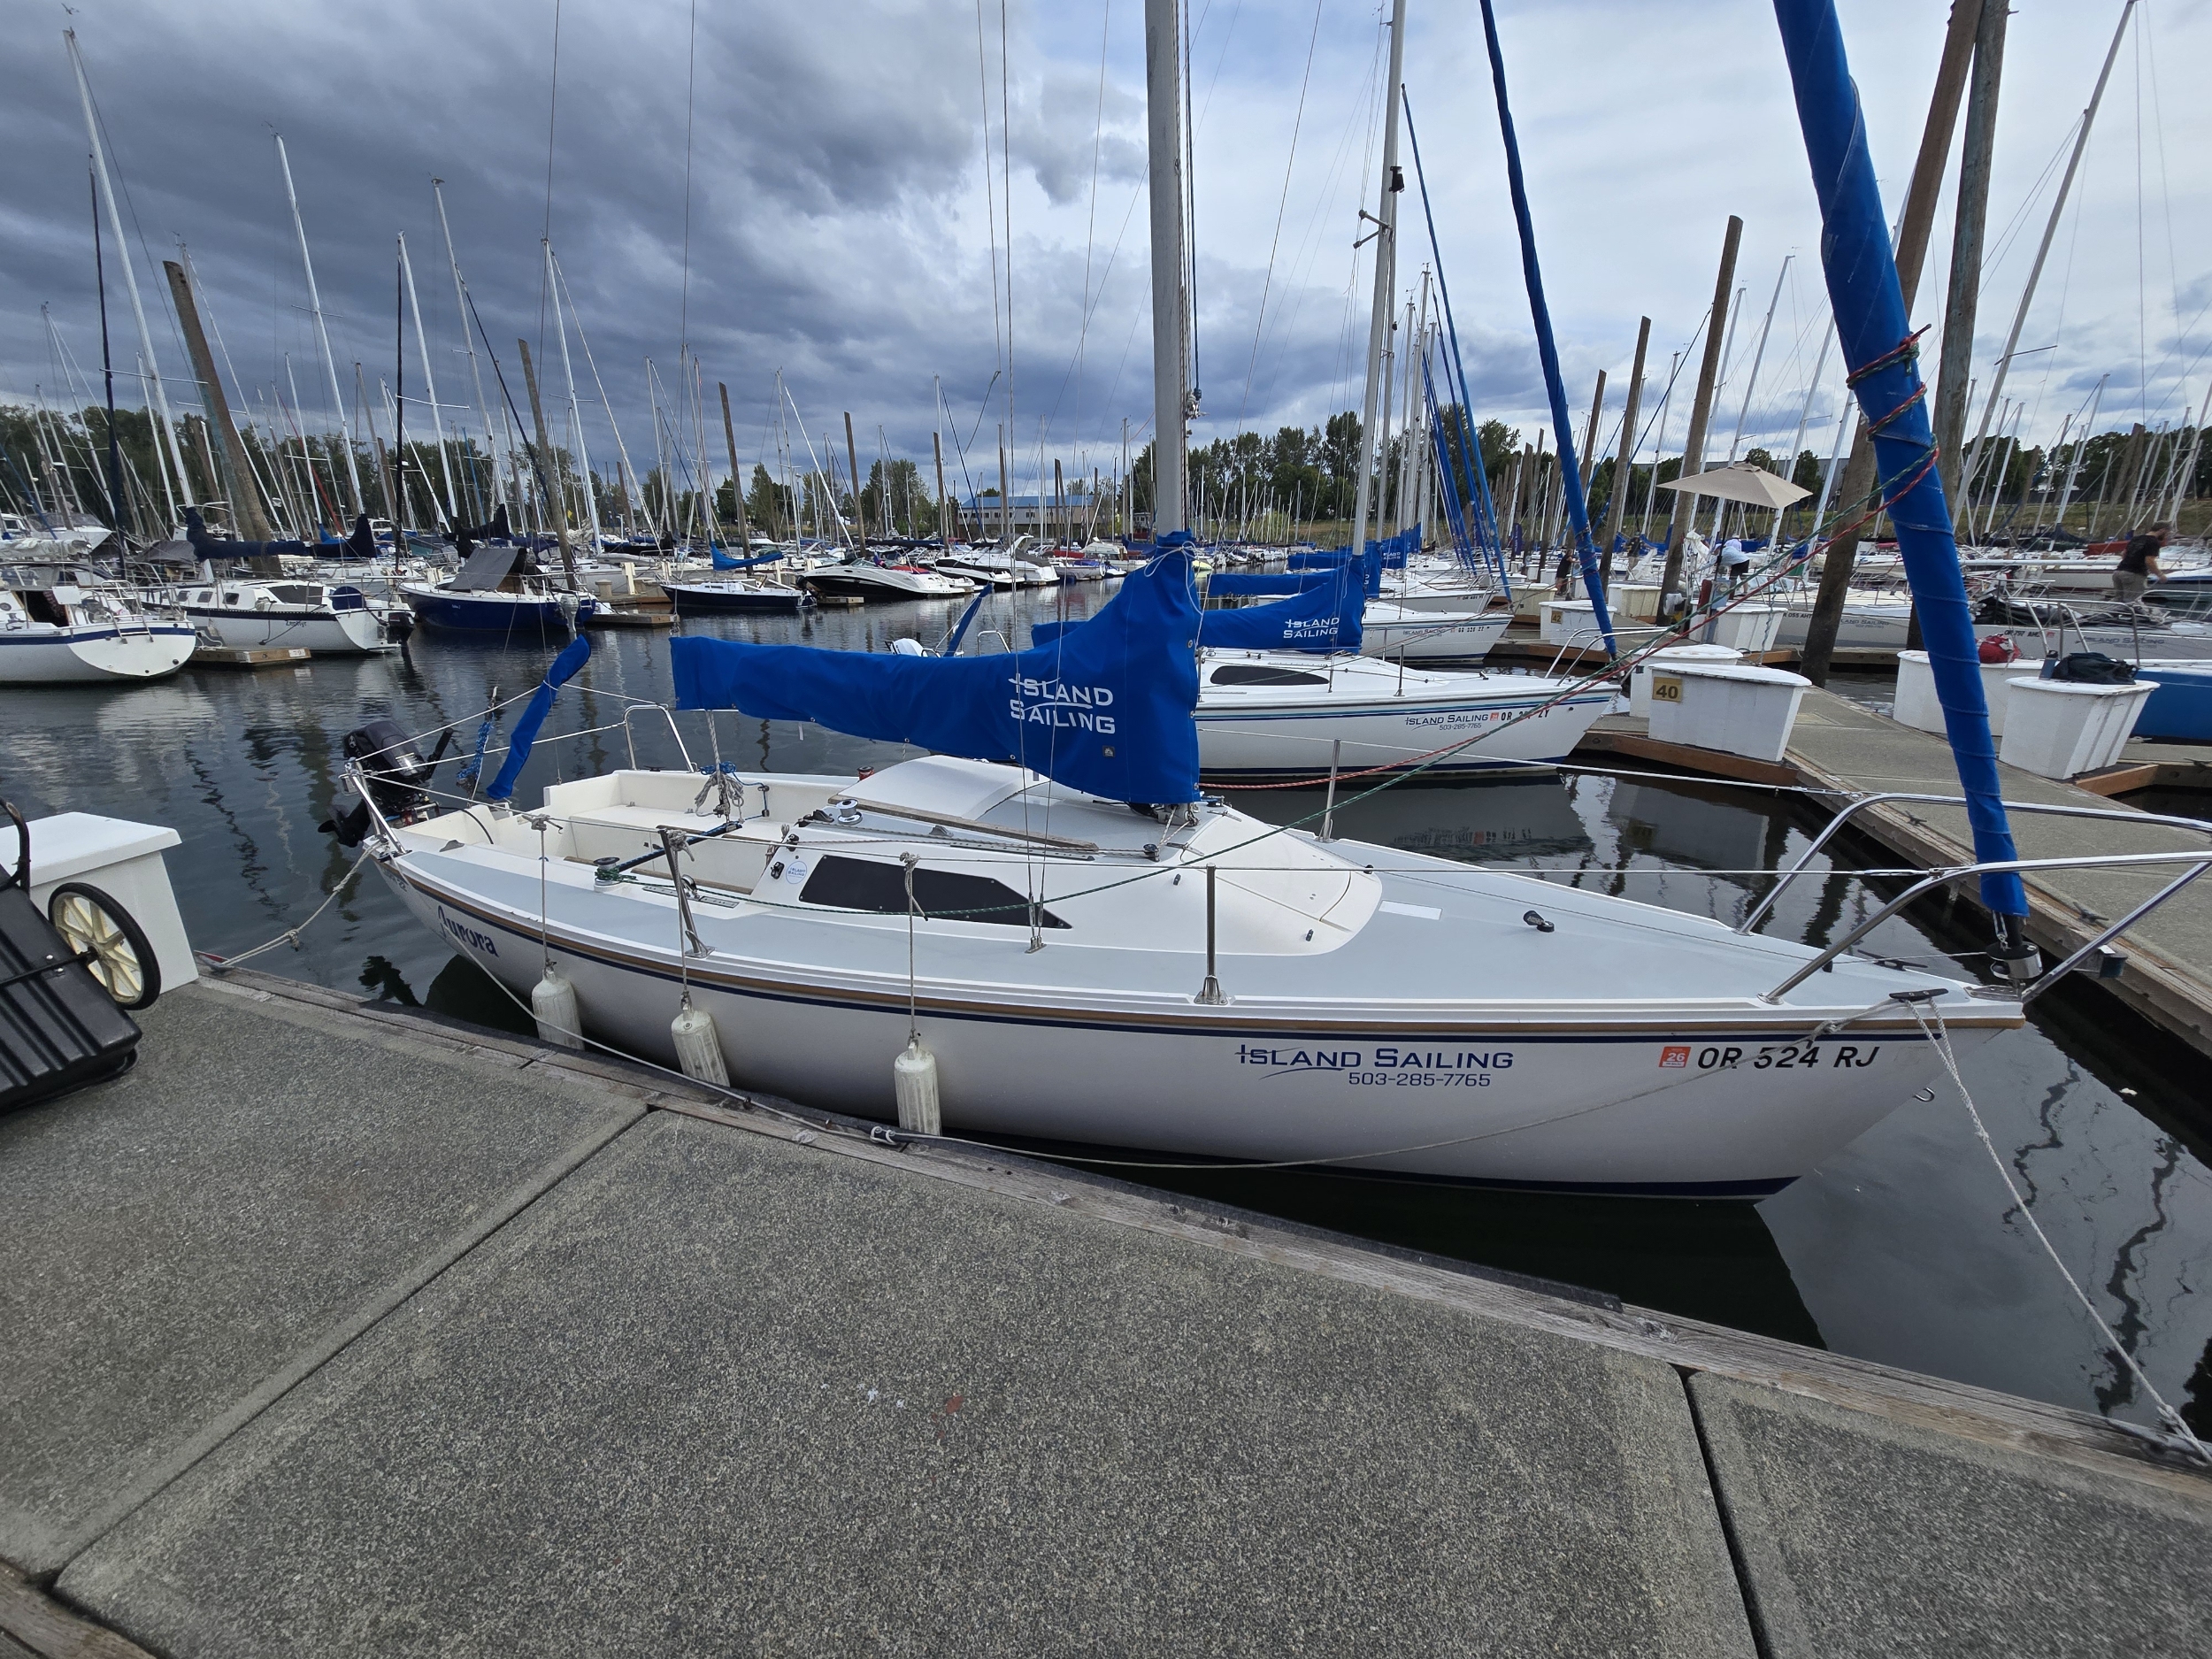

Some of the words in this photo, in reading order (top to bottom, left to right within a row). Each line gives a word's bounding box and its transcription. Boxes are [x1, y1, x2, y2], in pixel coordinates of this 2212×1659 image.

[1285, 617, 1340, 628] ISLAND
[1552, 614, 1562, 623] 42
[1283, 627, 1339, 639] SAILING
[1010, 672, 1114, 707] ISLAND
[1655, 684, 1679, 699] 40
[1010, 699, 1116, 734] SAILING
[1405, 716, 1445, 726] ISLAND
[1447, 714, 1489, 723] SAILING
[1501, 711, 1513, 721] OR
[1439, 722, 1483, 731] 503-285-7765
[1236, 1044, 1362, 1068] ISLAND
[1374, 1048, 1515, 1069] SAILING
[1666, 1052, 1686, 1062] 26
[1697, 1047, 1744, 1070] OR
[1753, 1046, 1820, 1070] 524
[1832, 1046, 1881, 1069] RJ
[1348, 1071, 1492, 1087] 503-285-7765
